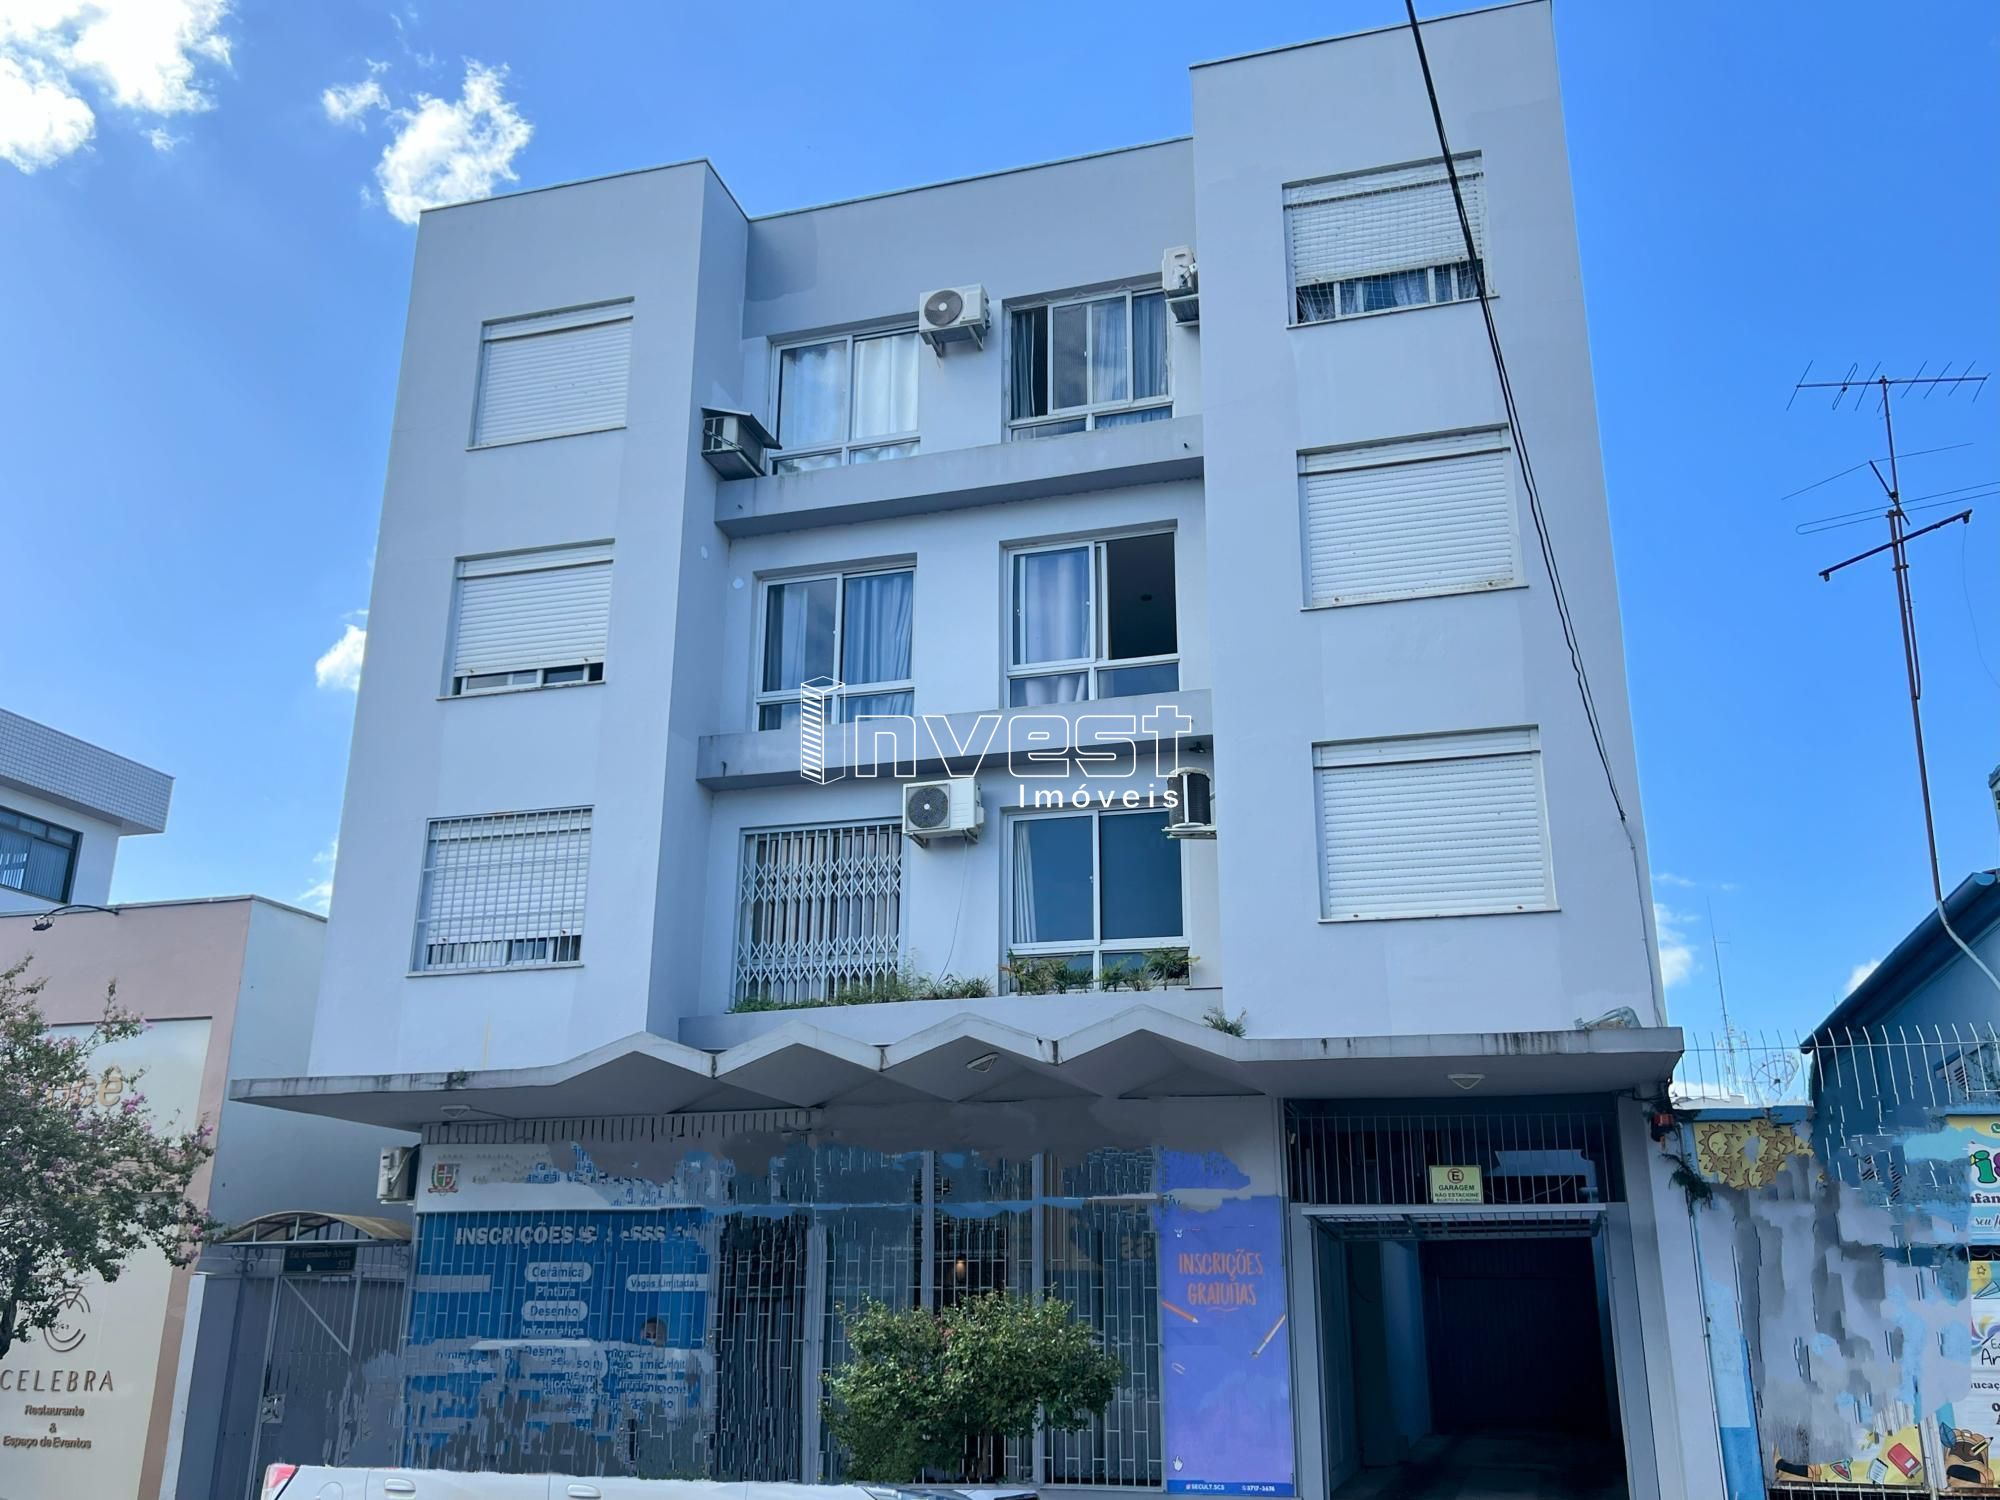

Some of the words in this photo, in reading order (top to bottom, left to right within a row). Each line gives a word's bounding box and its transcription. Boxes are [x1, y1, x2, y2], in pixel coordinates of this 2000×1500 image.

[455, 1222, 574, 1249] INSCRIÇÕES
[1178, 1248, 1264, 1281] INSCRIÇÕES
[532, 1265, 585, 1278] Cerâmica
[630, 1279, 656, 1289] Vagas
[660, 1277, 700, 1288] Limitadas
[536, 1285, 576, 1297] Pintura
[1187, 1281, 1257, 1306] GRATUITAS
[529, 1305, 579, 1317] Desenho
[0, 1369, 114, 1393] CELEBRA
[24, 1404, 85, 1417] Restaurante
[48, 1422, 57, 1434] &
[3, 1435, 38, 1450] Espaço
[39, 1436, 51, 1448] de
[52, 1437, 92, 1450] Eventos
